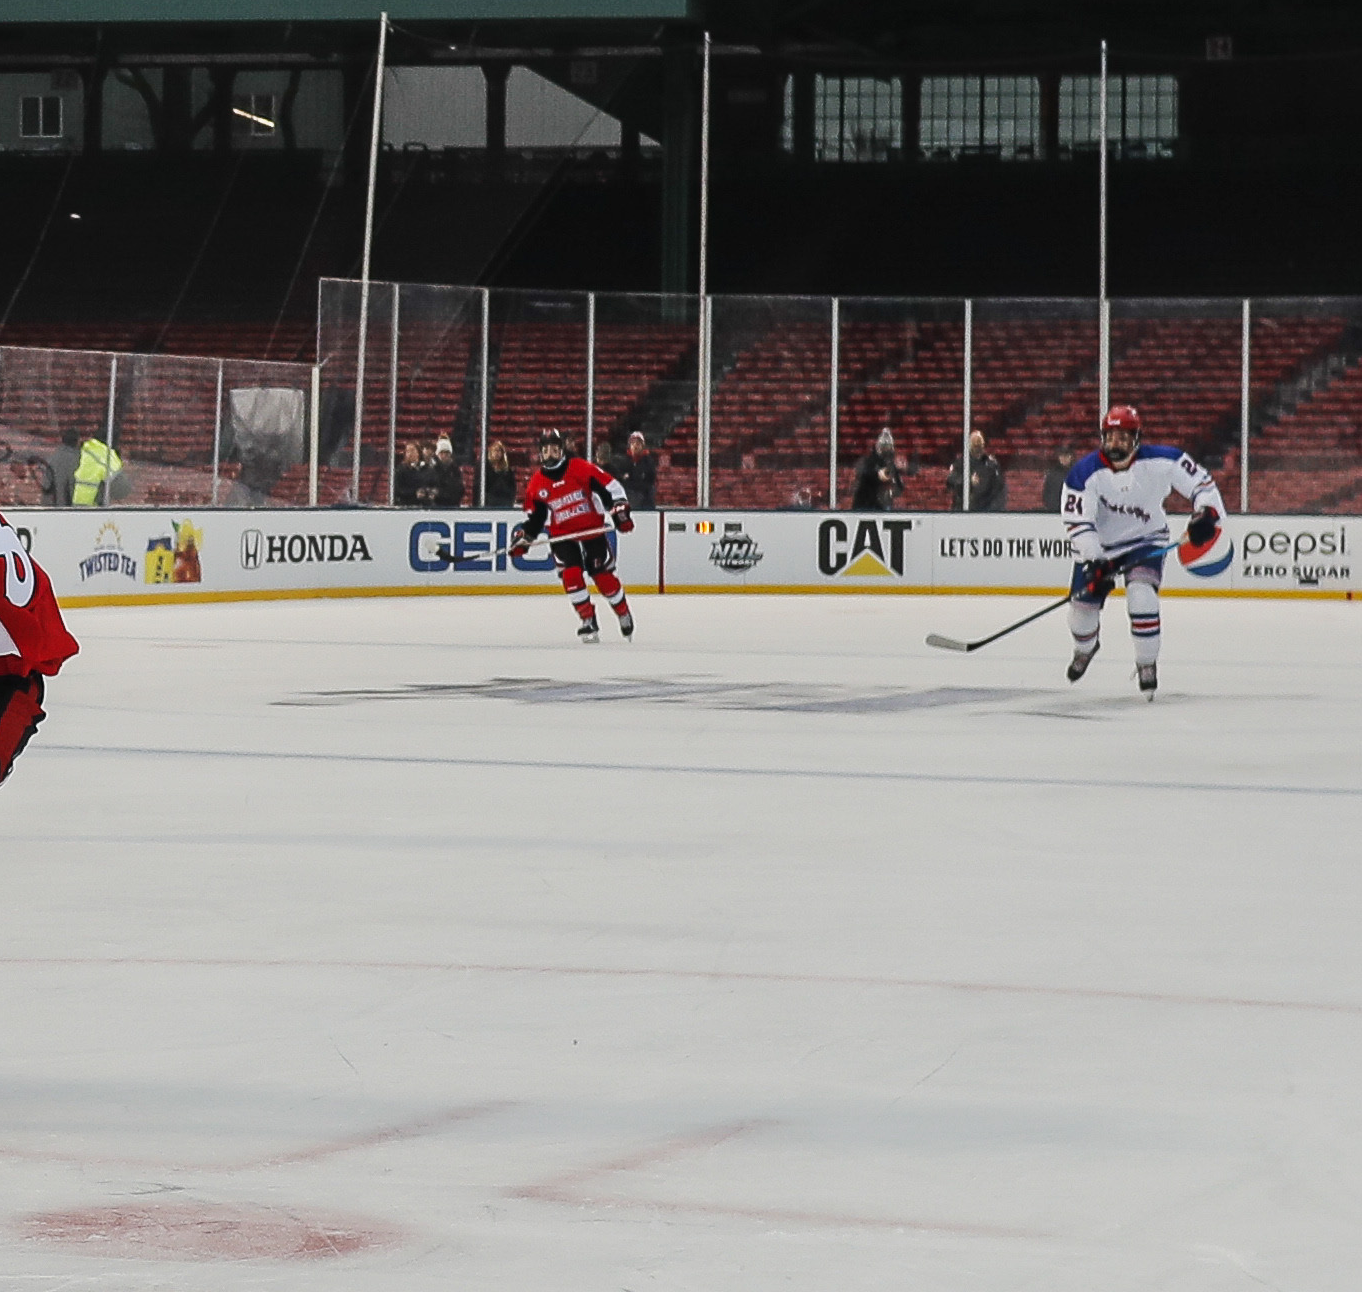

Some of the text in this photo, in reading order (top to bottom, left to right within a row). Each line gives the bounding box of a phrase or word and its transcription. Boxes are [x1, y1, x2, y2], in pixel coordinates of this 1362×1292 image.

[266, 534, 373, 563] HONDA
[708, 541, 764, 561] NHL
[818, 519, 913, 576] CAT
[940, 537, 1074, 560] LET'S DO THE WOR
[1242, 525, 1347, 561] pepsi
[79, 552, 137, 582] TWISTED TEA
[1242, 565, 1350, 580] ZERO SUGAR
